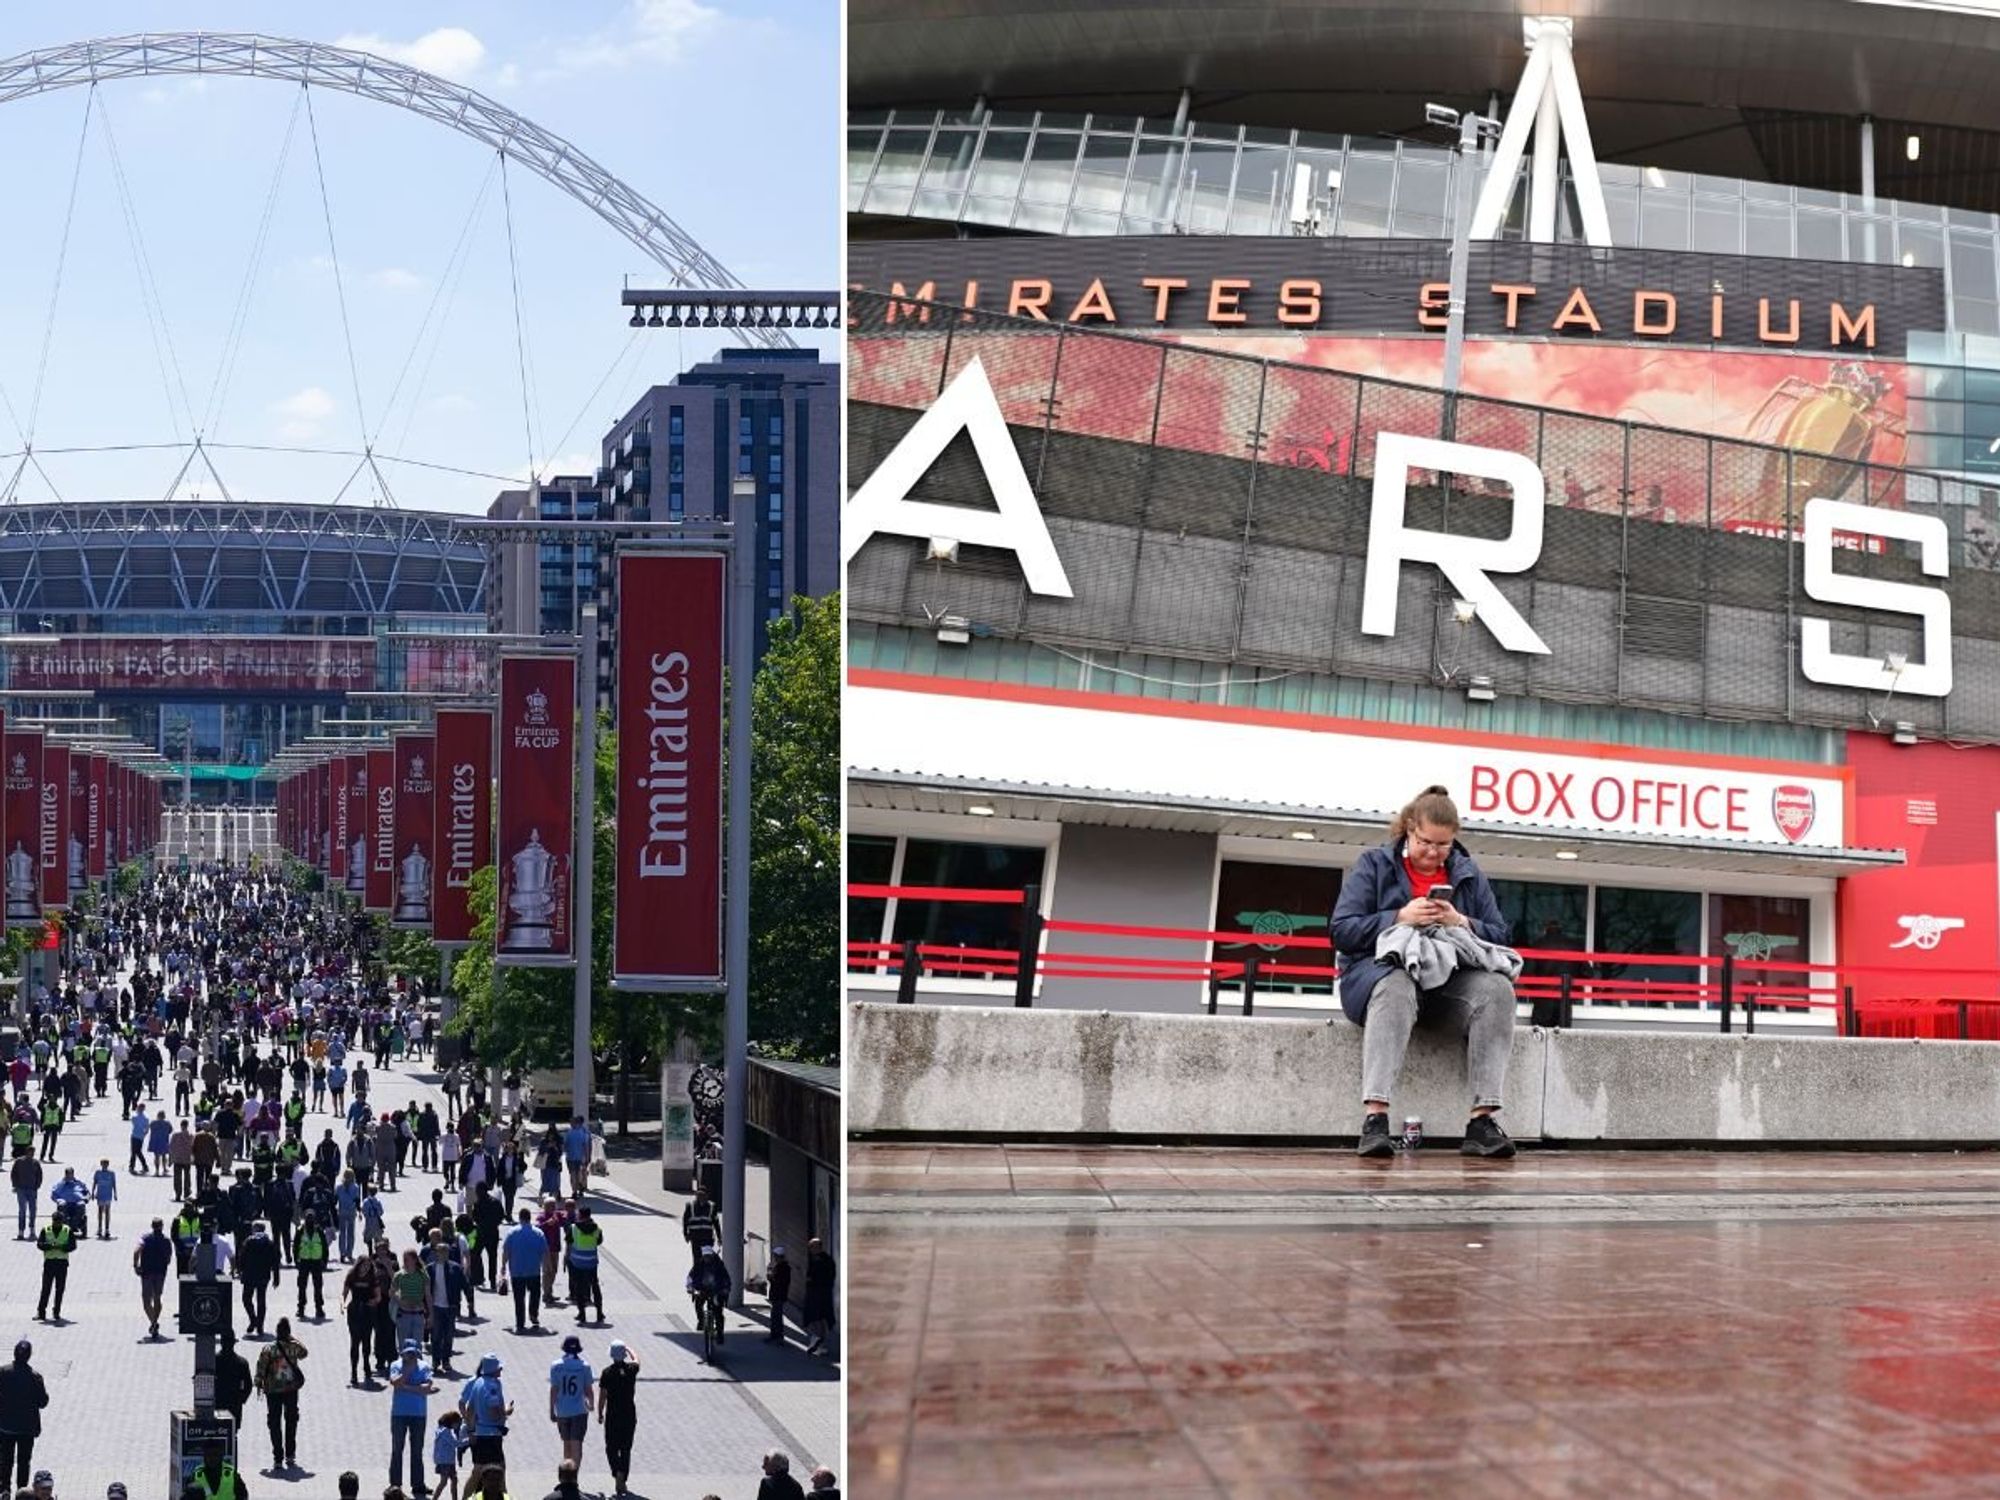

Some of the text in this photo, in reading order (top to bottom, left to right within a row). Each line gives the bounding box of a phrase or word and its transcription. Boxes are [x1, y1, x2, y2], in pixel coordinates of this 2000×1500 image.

[1417, 282, 1876, 348] STADIUM
[29, 655, 362, 678] Emirates FA CUP FINAL 2025
[515, 726, 559, 737] Emirates
[515, 737, 560, 748] FA CUP
[639, 651, 690, 880] Emirates
[374, 786, 393, 872] Emirates
[446, 762, 475, 889] Emirates
[1469, 765, 1750, 833] BOX OFFICE
[562, 1375, 578, 1396] 16
